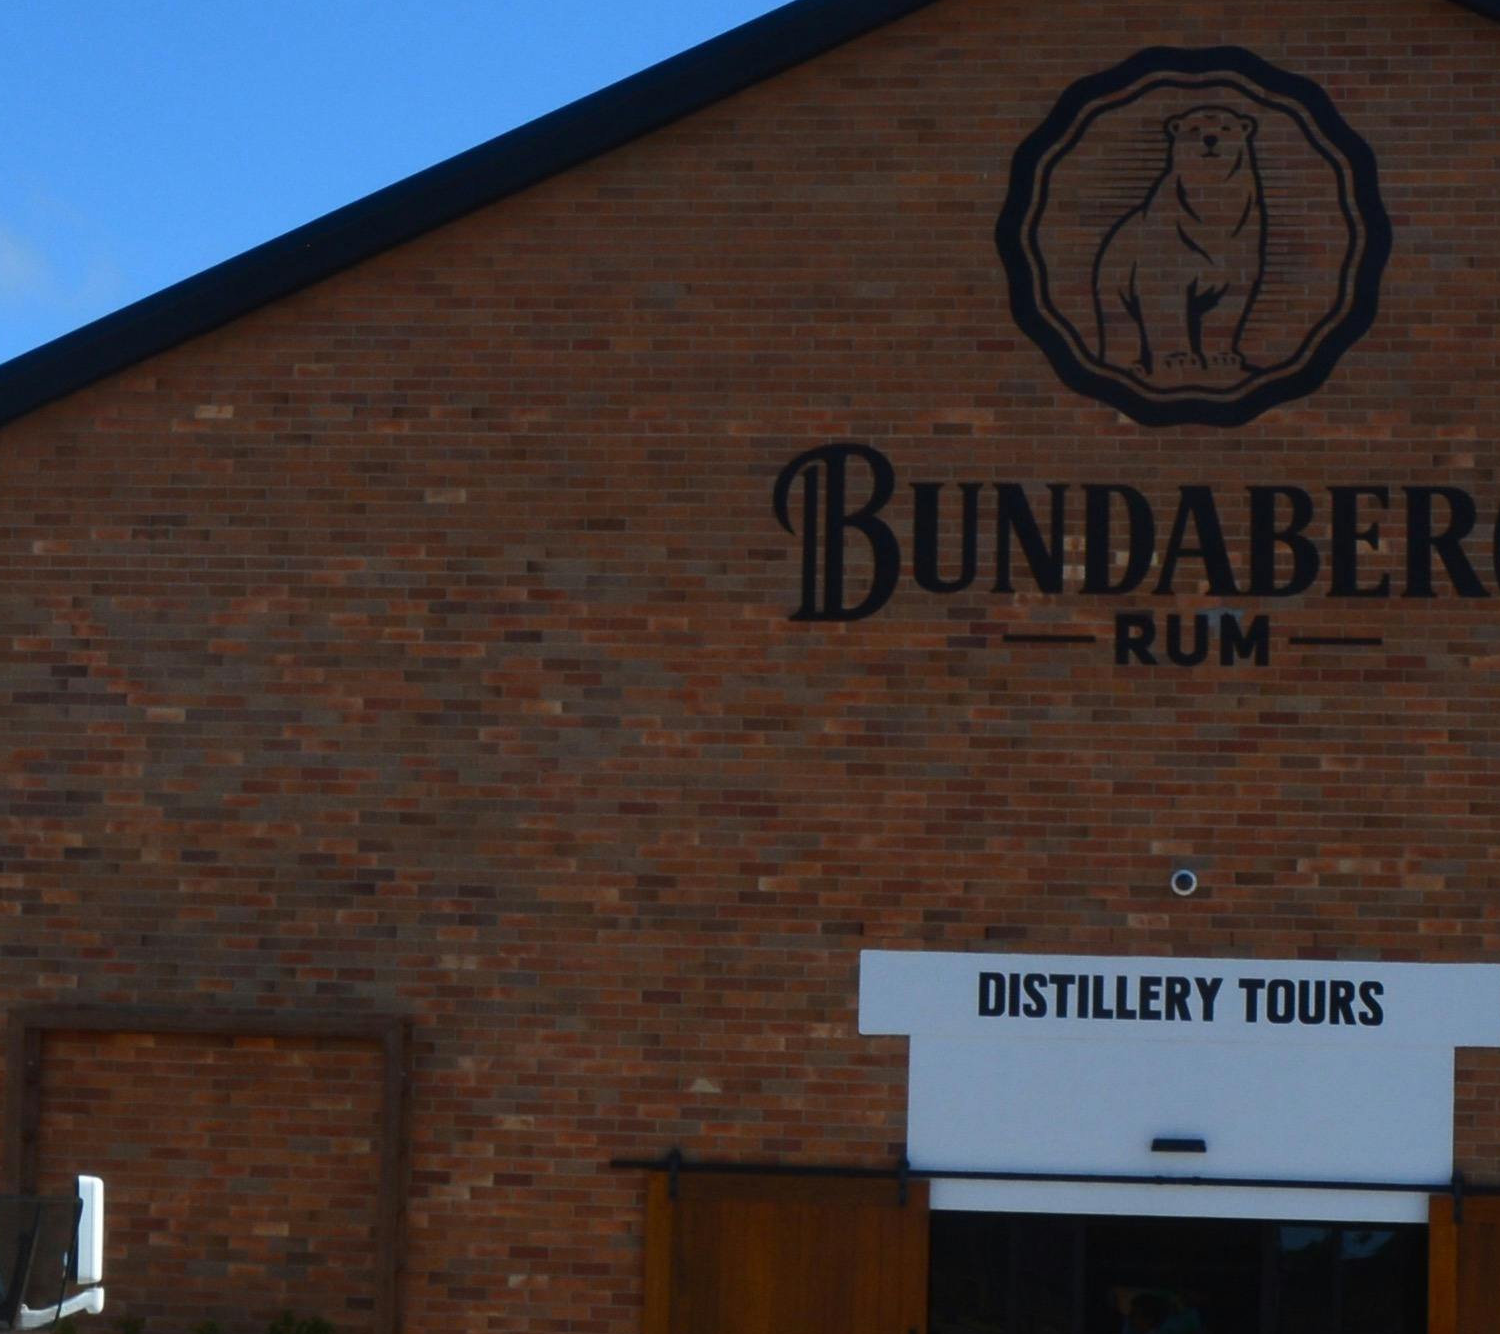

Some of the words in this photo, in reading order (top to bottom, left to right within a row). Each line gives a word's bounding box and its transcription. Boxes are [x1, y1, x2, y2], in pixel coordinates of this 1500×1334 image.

[1113, 613, 1271, 667] RUM
[978, 972, 1224, 1023] DISTILLERY
[1238, 978, 1385, 1027] TOURS
